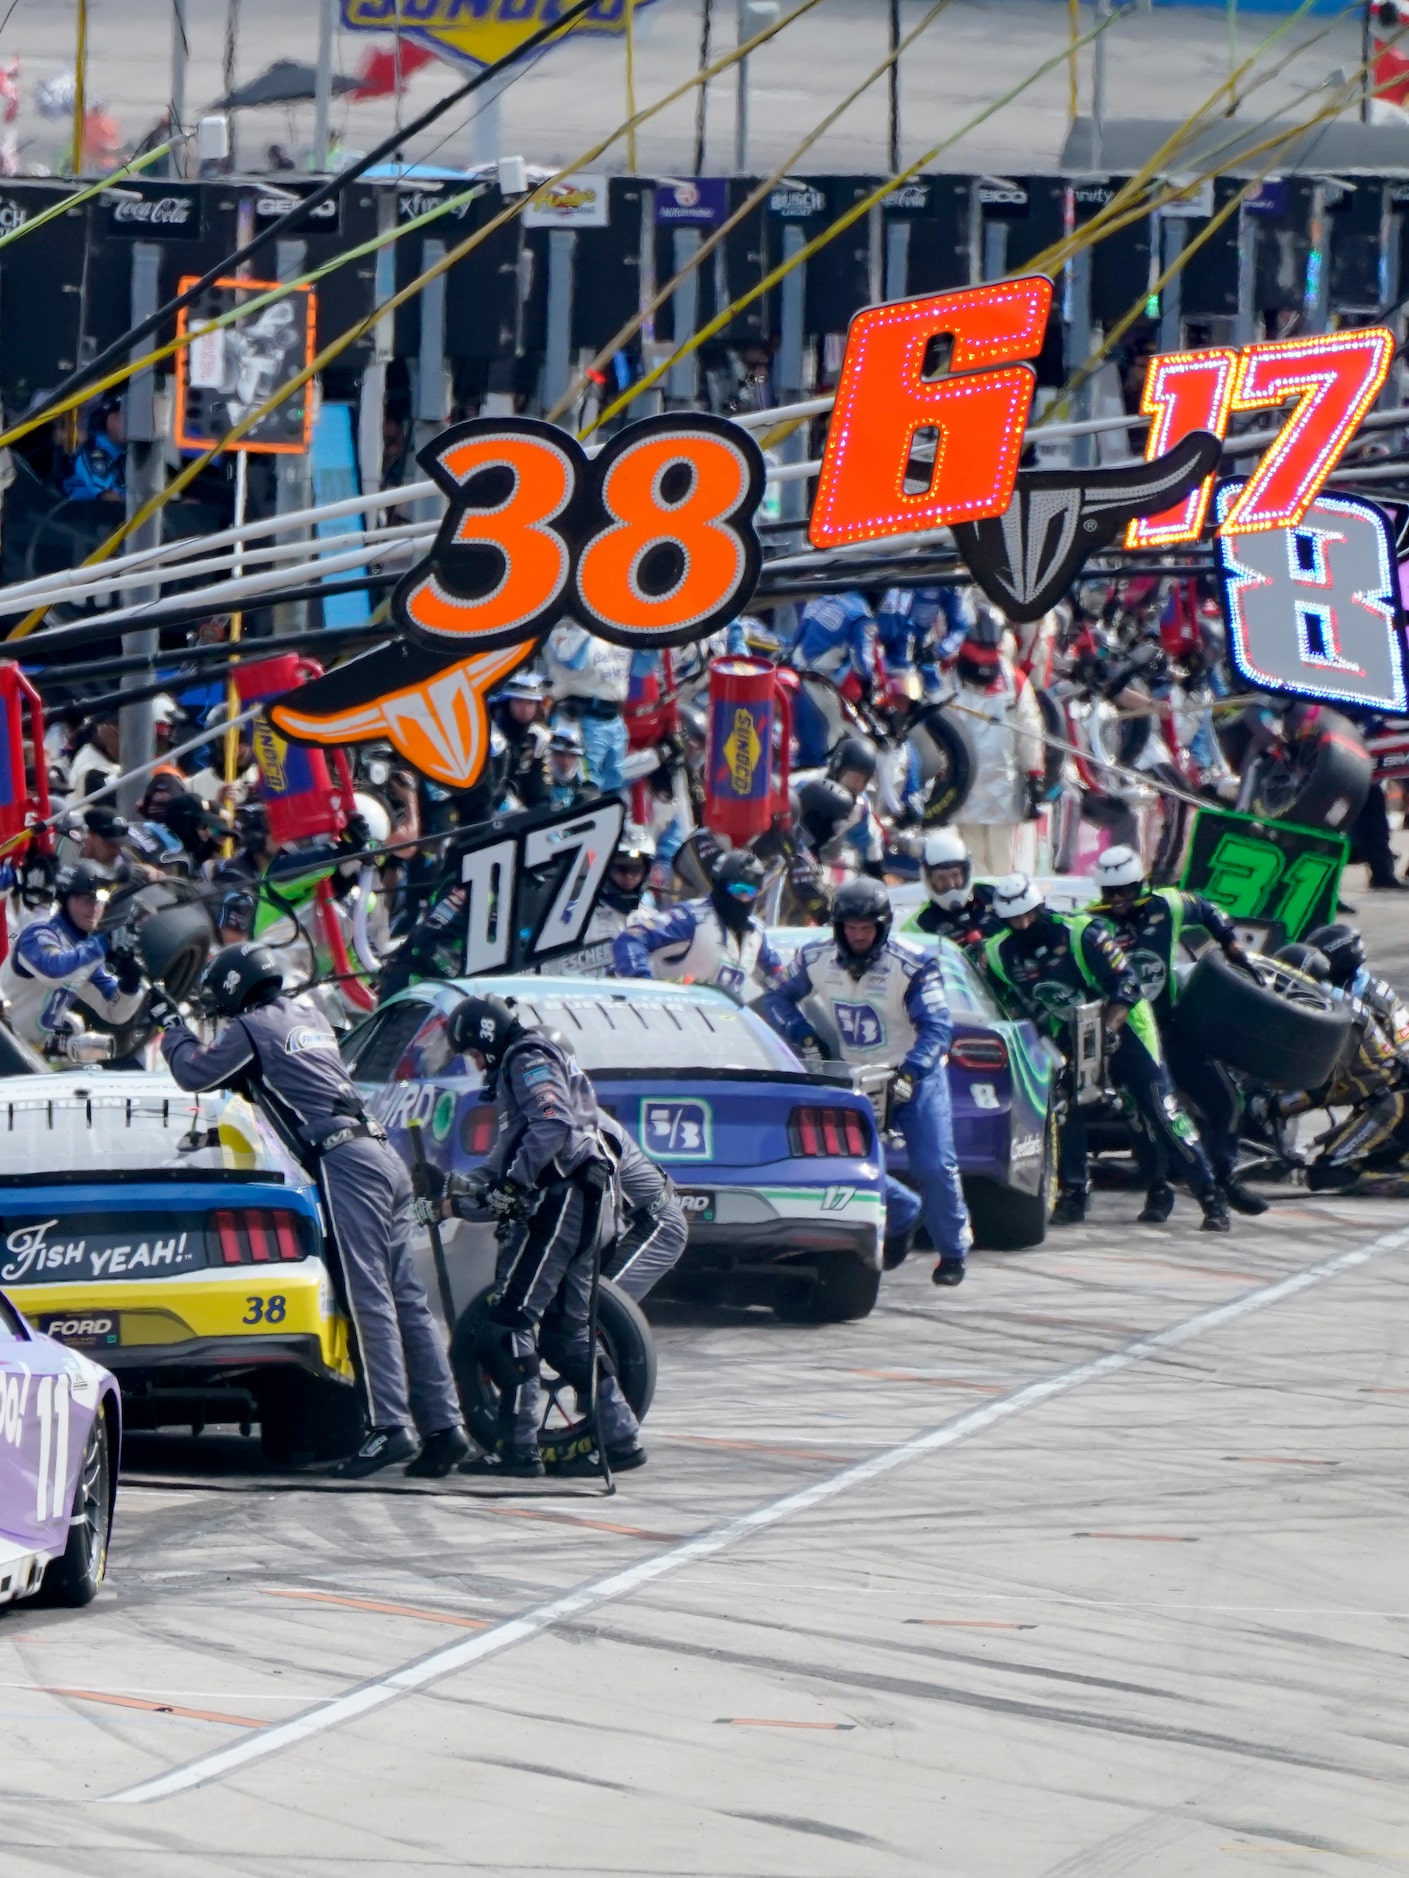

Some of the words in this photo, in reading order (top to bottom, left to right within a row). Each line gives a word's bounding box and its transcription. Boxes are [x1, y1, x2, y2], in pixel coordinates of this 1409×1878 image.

[979, 190, 1028, 204] EICO
[808, 275, 1054, 549] 6
[1124, 327, 1395, 549] 17
[405, 430, 752, 640] 38
[731, 713, 754, 788] SUNOCO
[1204, 832, 1338, 945] 31
[479, 1017, 497, 1043] 38
[821, 1185, 857, 1211] 17
[89, 1231, 187, 1277] YEAH!
[47, 1319, 112, 1337] FORD
[242, 1295, 287, 1325] 38
[34, 1371, 71, 1523] 11
